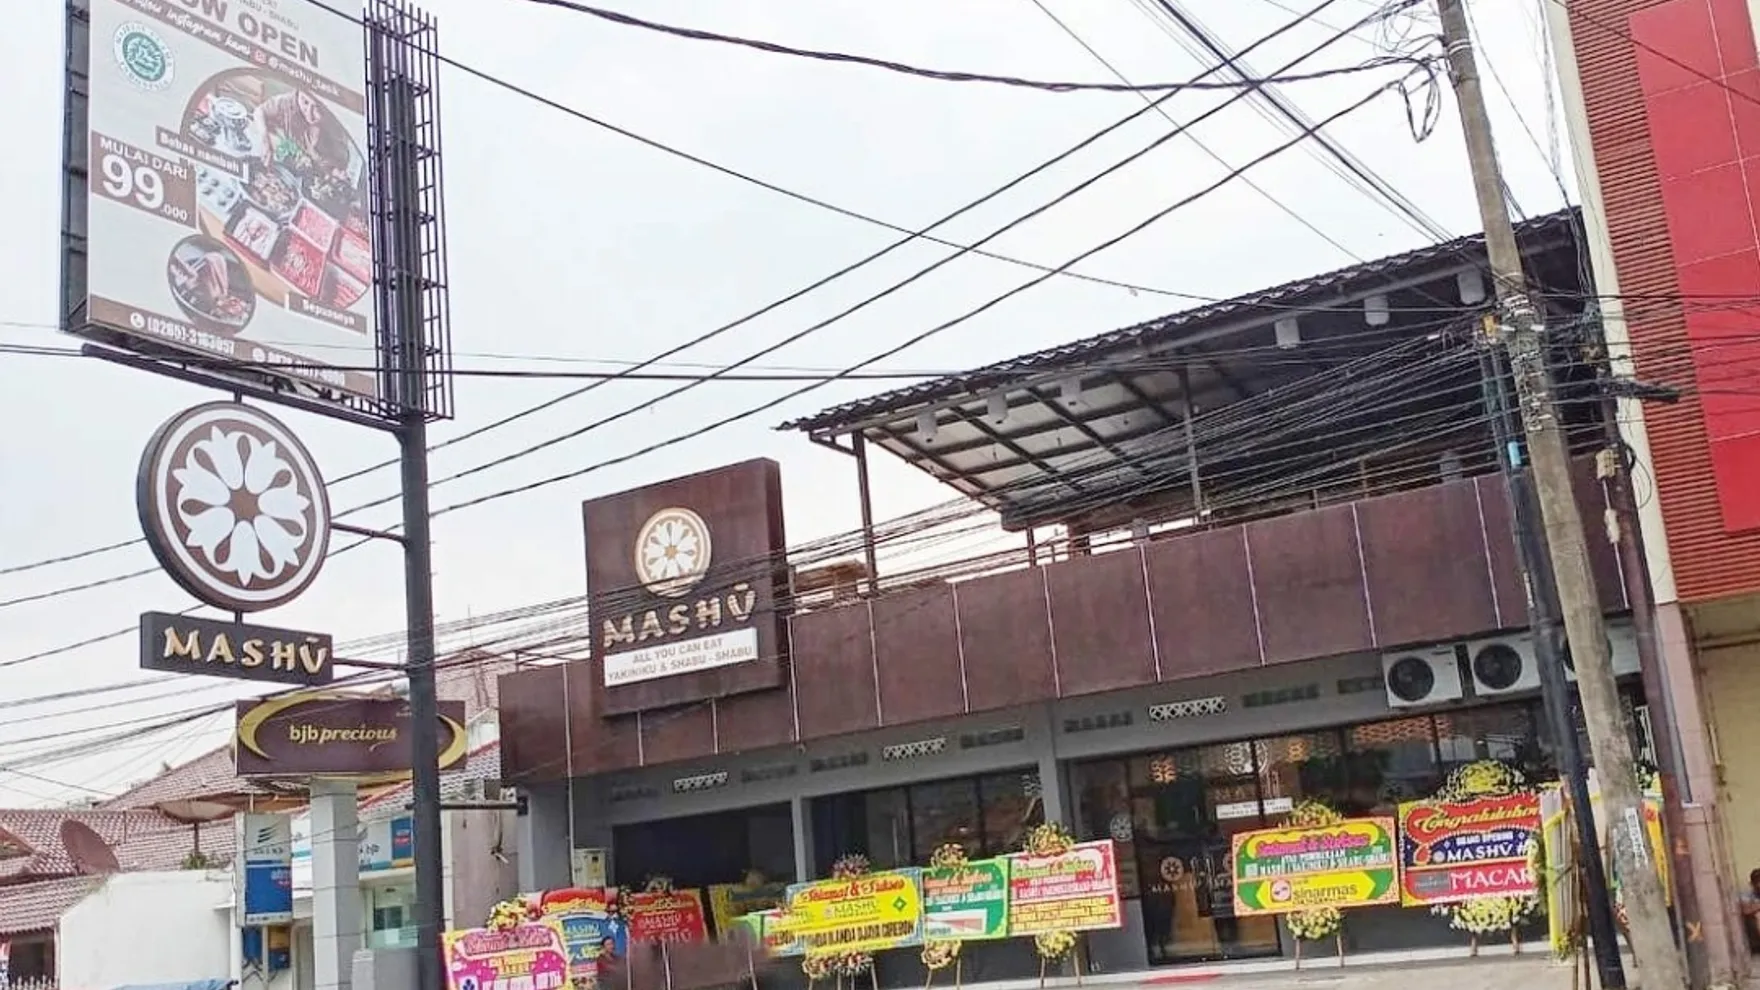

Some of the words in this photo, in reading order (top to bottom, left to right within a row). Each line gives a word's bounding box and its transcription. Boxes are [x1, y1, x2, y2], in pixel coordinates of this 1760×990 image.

[238, 11, 319, 68] OPEN
[100, 137, 149, 164] MULAI
[152, 157, 188, 180] DARI
[102, 153, 165, 210] 99
[608, 665, 656, 682] YAKINIKU
[660, 663, 667, 673] &
[671, 656, 706, 670] SHABU
[715, 647, 752, 662] SHABU
[633, 652, 651, 664] ALL
[655, 647, 676, 659] YOU
[678, 643, 700, 655] CAN
[703, 638, 723, 649] EAT
[289, 724, 318, 744] bjb
[319, 723, 398, 744] precious
[850, 879, 860, 896] &
